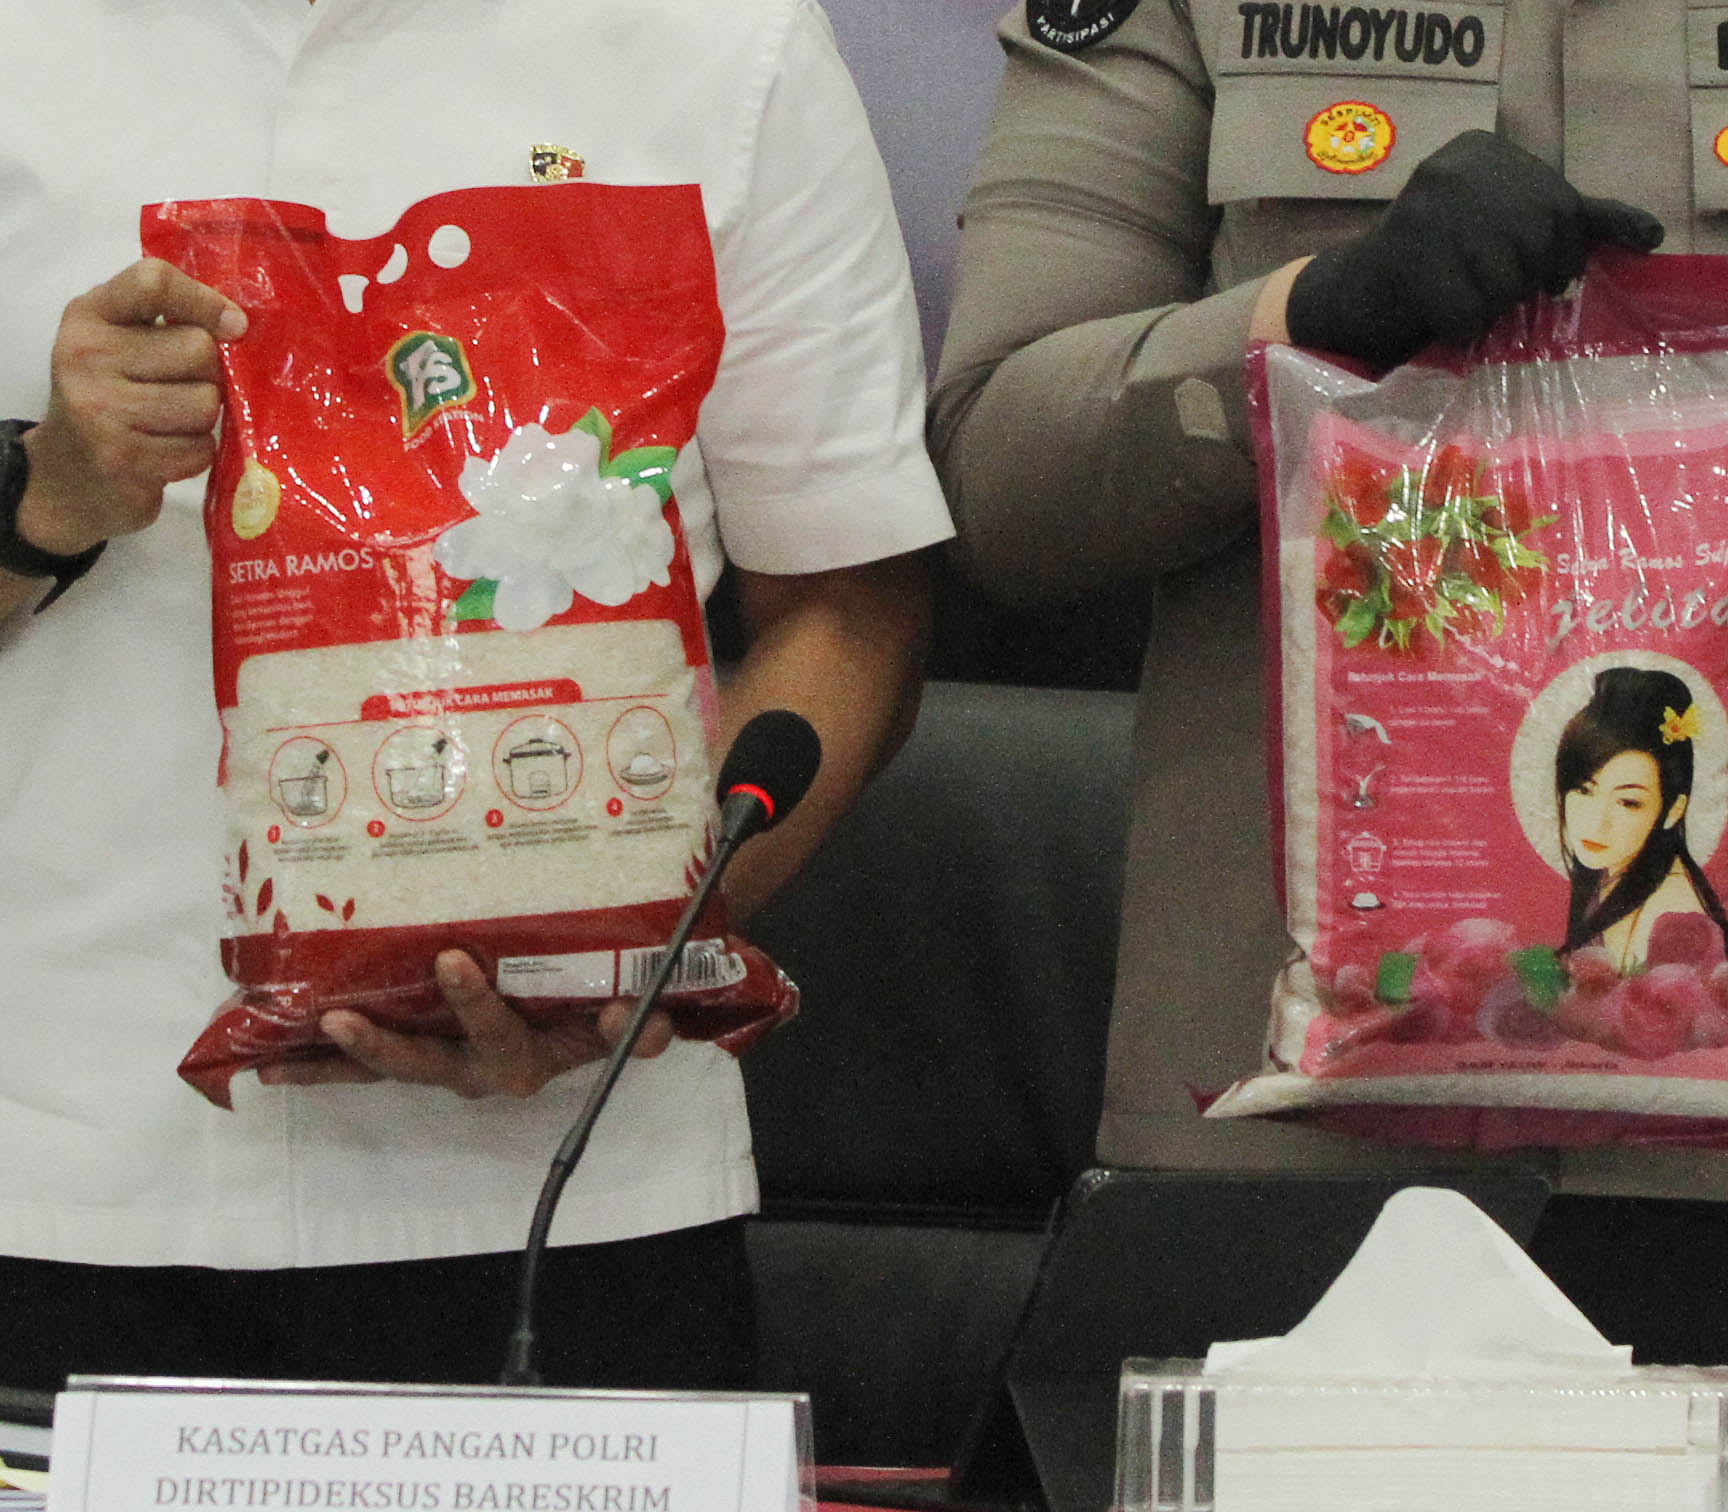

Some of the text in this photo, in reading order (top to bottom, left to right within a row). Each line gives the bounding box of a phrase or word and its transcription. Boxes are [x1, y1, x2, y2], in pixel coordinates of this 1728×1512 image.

[1238, 2, 1485, 68] TRUNOYUDO
[229, 547, 374, 584] SETRA RAMOS
[491, 687, 554, 702] MEMASAK
[176, 1426, 660, 1463] KASATGAS PANGAN POLRI
[154, 1477, 672, 1512] DIRTIPIDEKSUS BARESKRIM
